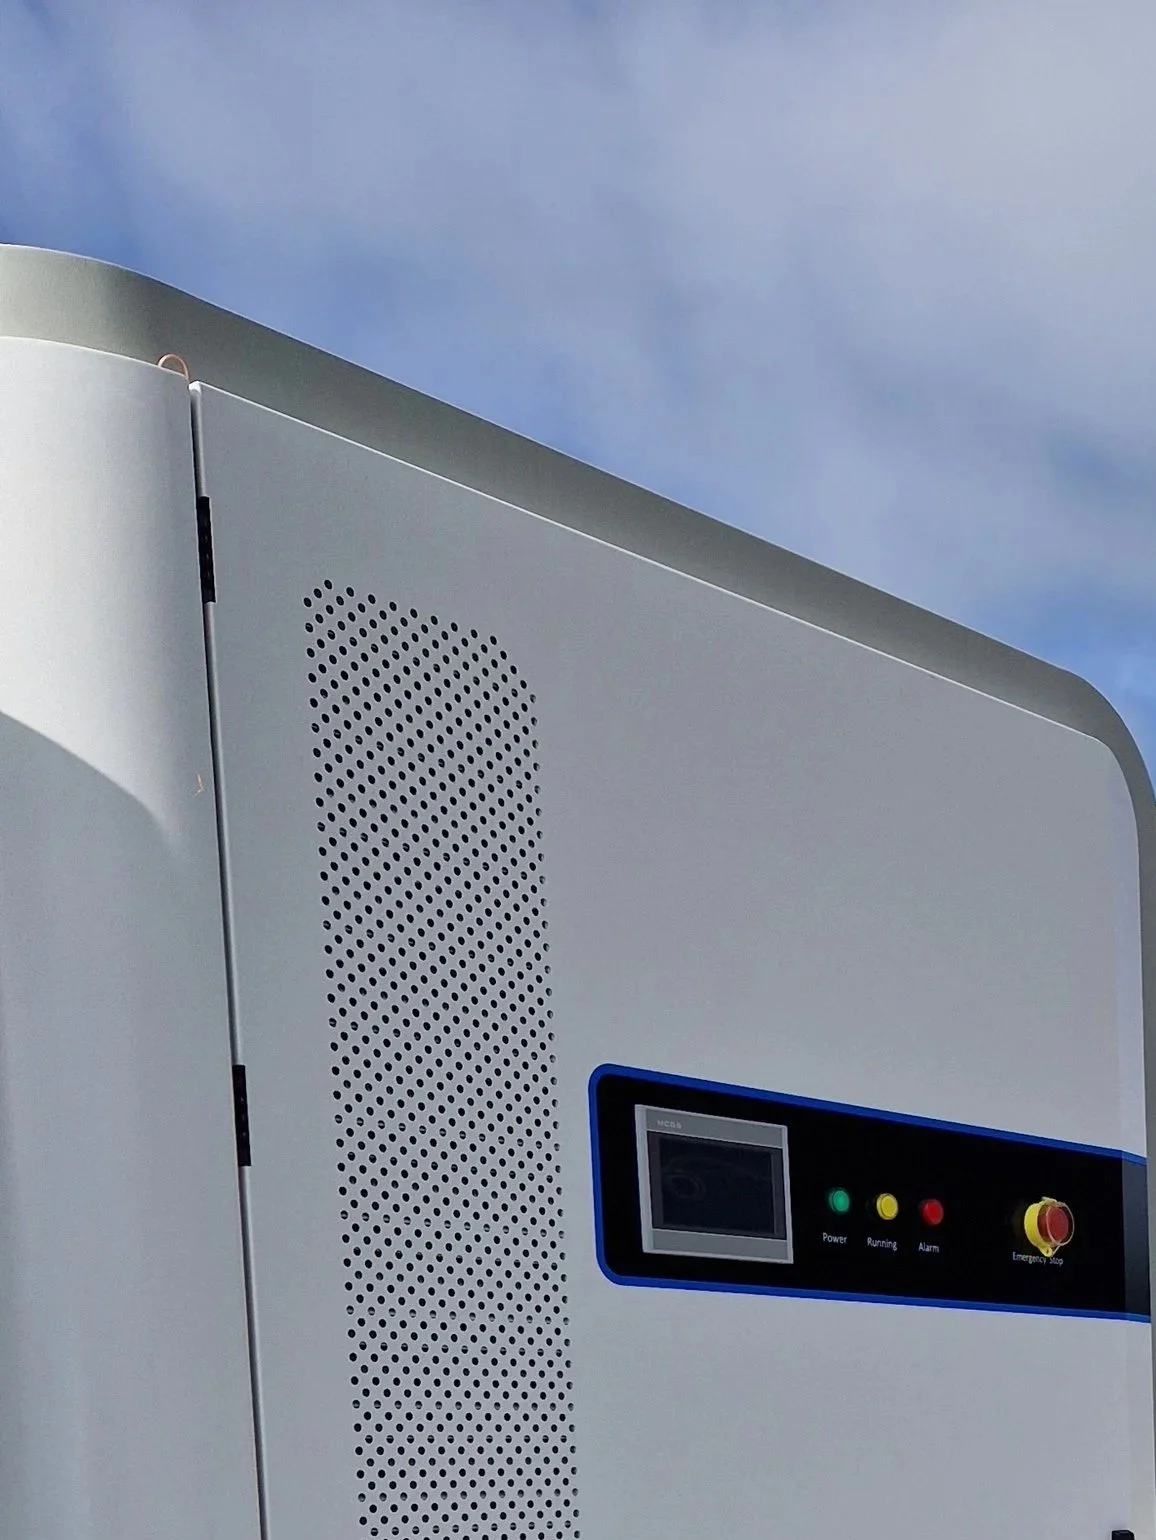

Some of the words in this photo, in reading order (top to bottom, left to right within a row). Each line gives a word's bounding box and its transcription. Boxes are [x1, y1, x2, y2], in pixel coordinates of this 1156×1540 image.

[822, 1232, 848, 1244] Power
[867, 1237, 898, 1252] Running
[918, 1242, 940, 1253] Alarm
[1012, 1251, 1047, 1265] Emergency
